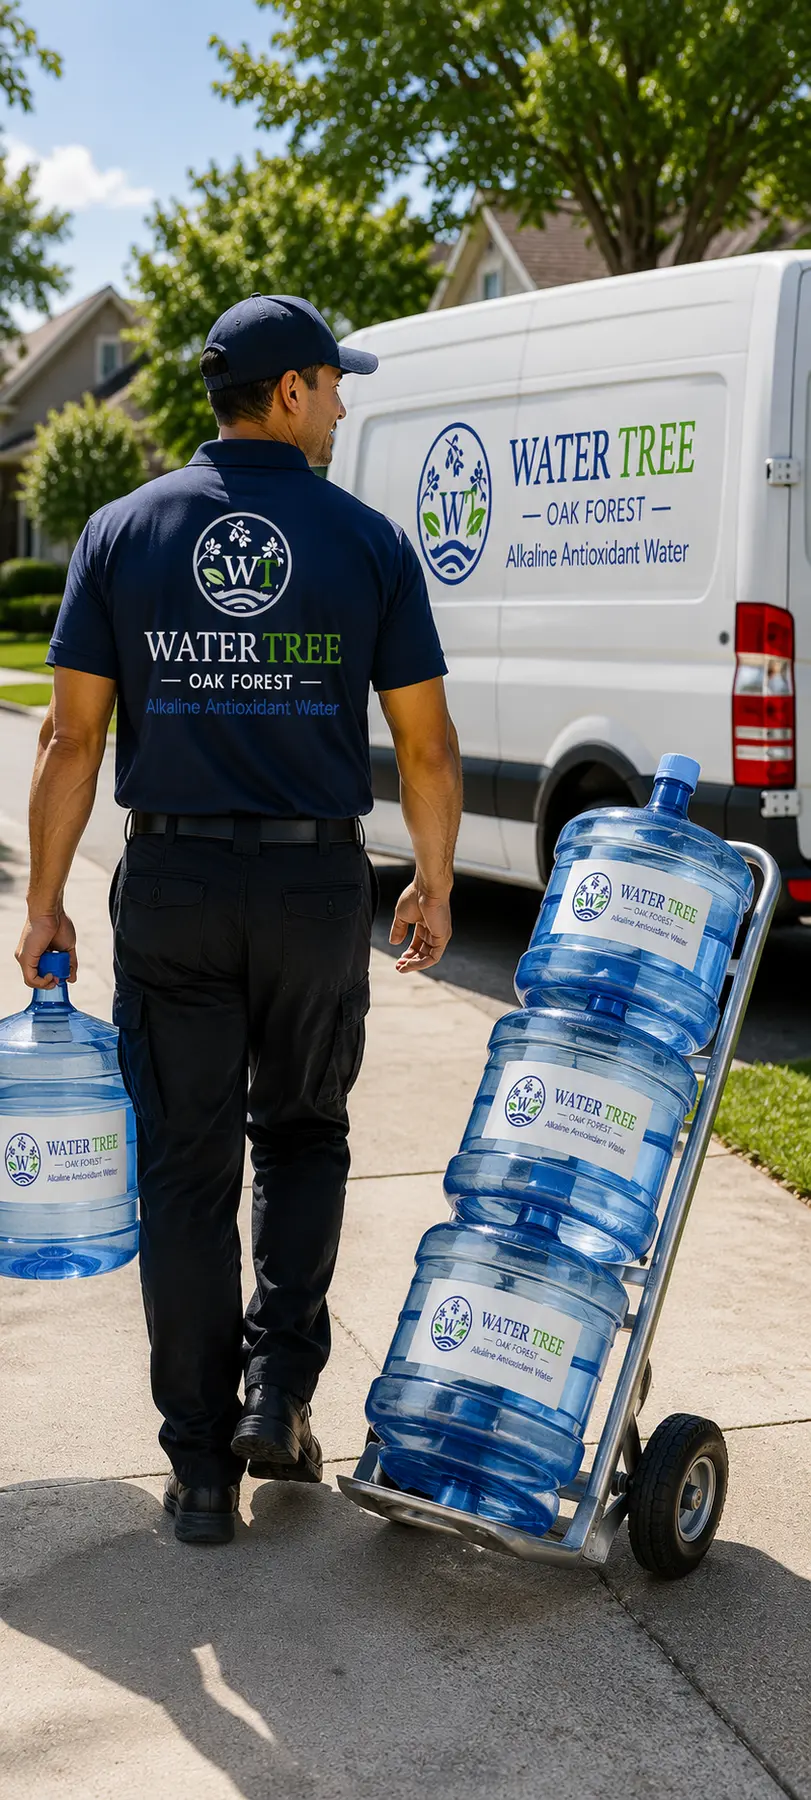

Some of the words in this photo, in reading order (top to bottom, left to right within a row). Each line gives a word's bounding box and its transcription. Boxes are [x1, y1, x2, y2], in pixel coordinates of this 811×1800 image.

[509, 429, 611, 487] WATER
[618, 420, 696, 478] TREE
[547, 501, 580, 526] OAK
[585, 496, 645, 524] FOREST
[506, 543, 557, 568] Alkaline
[560, 541, 640, 567] Antioxidant
[643, 538, 690, 564] Water
[222, 555, 279, 588] WT
[144, 631, 260, 663] WATER
[262, 633, 342, 665] TREE
[189, 673, 225, 690] OAK
[231, 673, 293, 690] FOREST
[145, 698, 200, 716] Alkaline
[205, 698, 291, 716] Antioxidant
[295, 699, 340, 716] Water
[621, 884, 666, 911] WATER
[667, 897, 698, 924] TREE
[555, 1088, 603, 1117] WATER
[604, 1103, 638, 1131] TREE
[46, 1138, 91, 1156] WATER
[92, 1133, 118, 1152] TREE
[481, 1311, 530, 1342] WATER
[531, 1328, 565, 1357] TREE
[495, 1338, 511, 1351] OAK
[511, 1344, 539, 1360] FOREST
